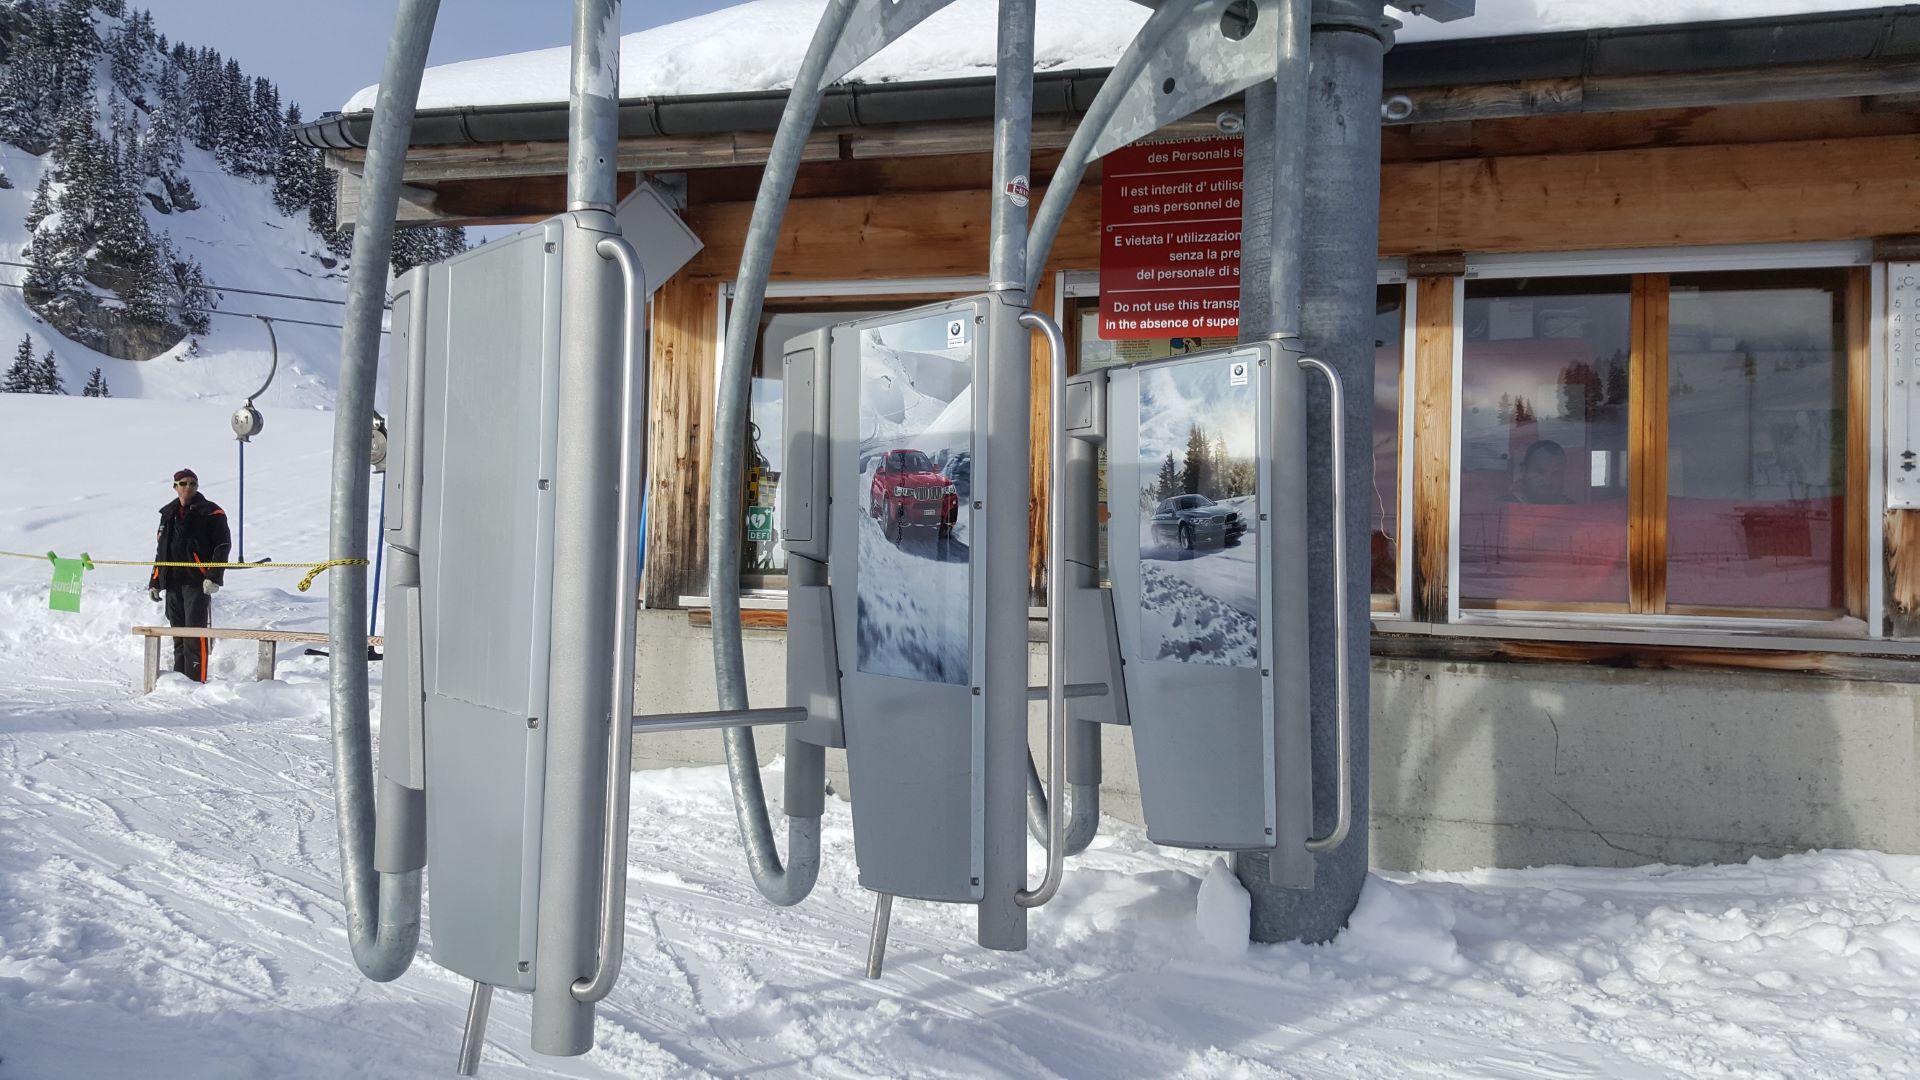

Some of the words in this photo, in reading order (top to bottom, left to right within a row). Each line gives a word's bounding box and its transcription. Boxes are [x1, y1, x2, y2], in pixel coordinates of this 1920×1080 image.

[1148, 152, 1169, 163] des
[1172, 147, 1230, 162] Personals
[1121, 186, 1128, 197] Il
[1131, 186, 1149, 196] est
[1152, 182, 1193, 195] interdit
[1133, 204, 1160, 214] sans
[1163, 198, 1222, 214] personnel
[1225, 197, 1241, 208] de
[1115, 236, 1122, 247] E
[1125, 234, 1163, 246] vietata
[1169, 250, 1204, 261] senza
[1207, 249, 1217, 260] la
[1221, 249, 1241, 261] pre
[1136, 268, 1155, 280] del
[1157, 266, 1215, 281] personale
[1218, 265, 1230, 277] di
[1114, 301, 1130, 313] Do
[1132, 301, 1152, 312] not
[1154, 302, 1175, 312] use
[1178, 299, 1199, 311] this
[1202, 299, 1240, 311] transp
[1106, 319, 1116, 330] in
[1119, 319, 1137, 329] the
[1140, 317, 1189, 329] absence
[1192, 316, 1205, 327] of
[750, 531, 770, 540] DEFI
